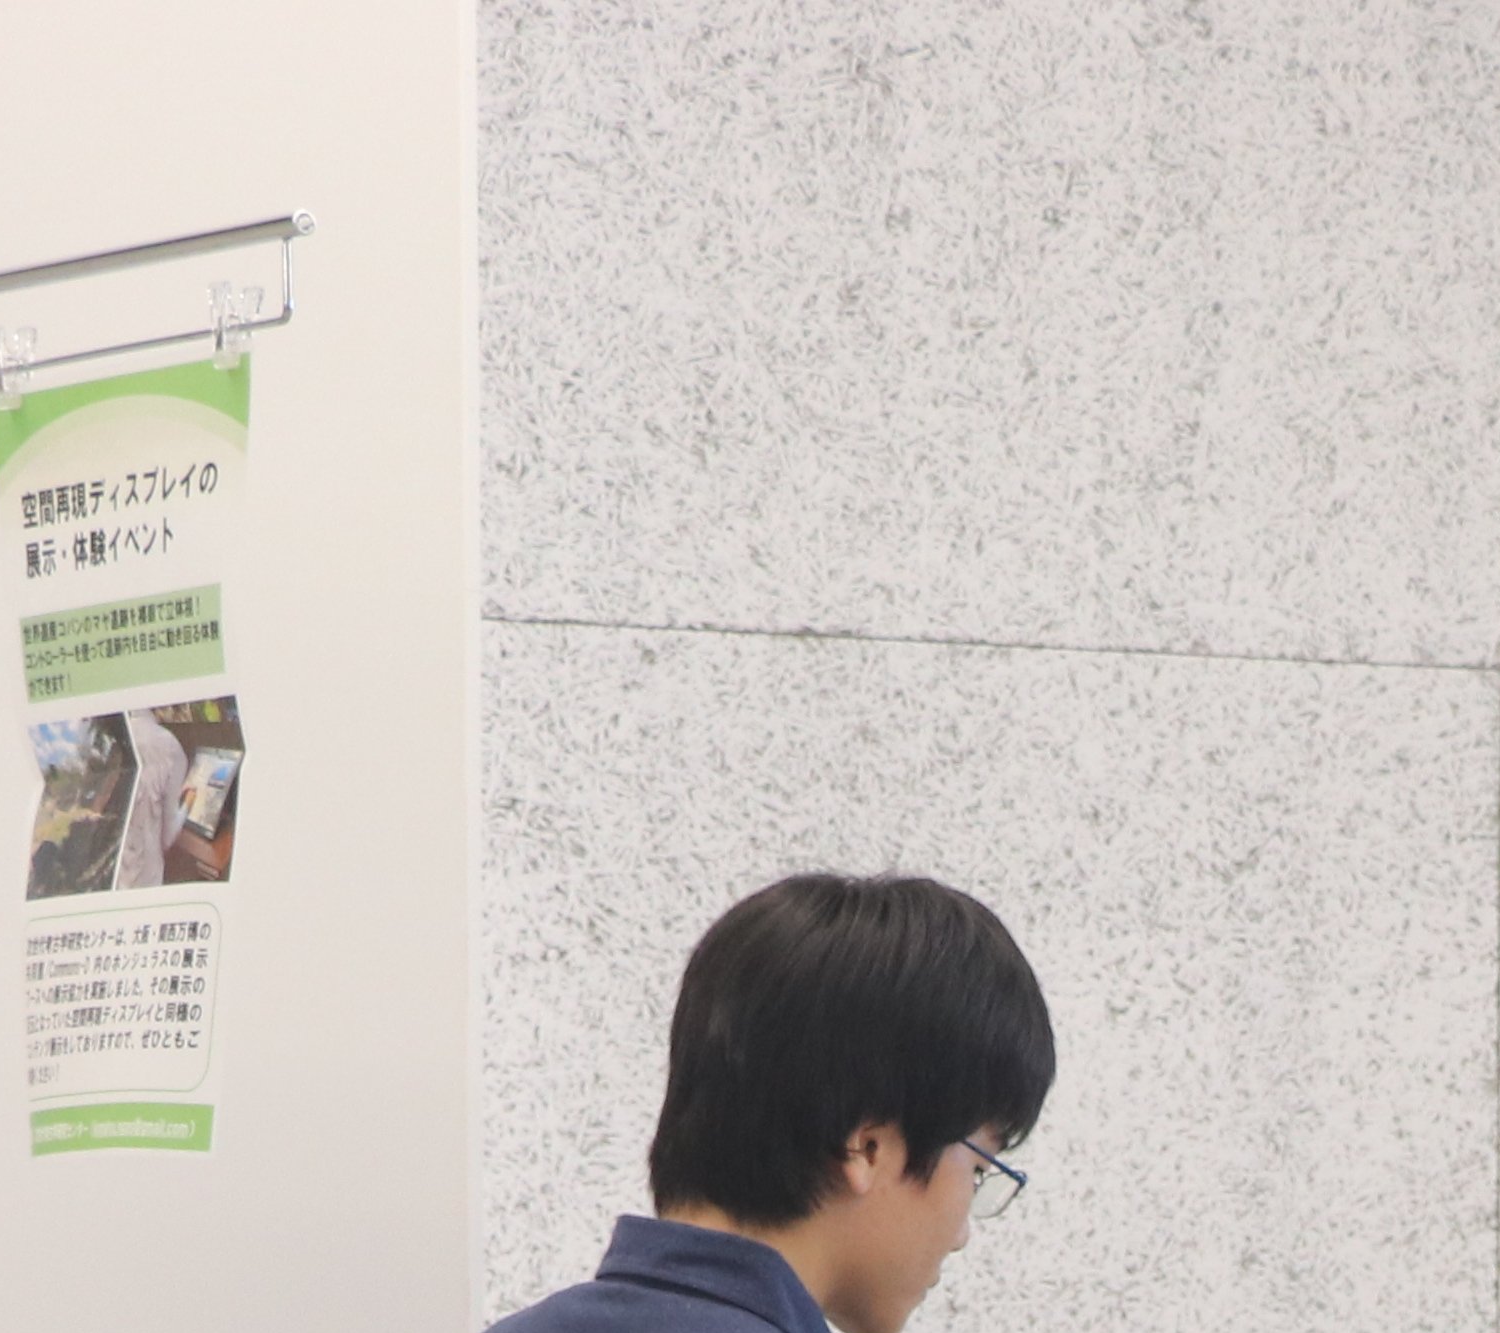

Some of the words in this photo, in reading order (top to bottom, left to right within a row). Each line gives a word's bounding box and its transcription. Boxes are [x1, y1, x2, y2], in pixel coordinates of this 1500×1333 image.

[22, 462, 218, 529] 空間再現ディスプレイの
[25, 517, 174, 579] 展示・体験イベント
